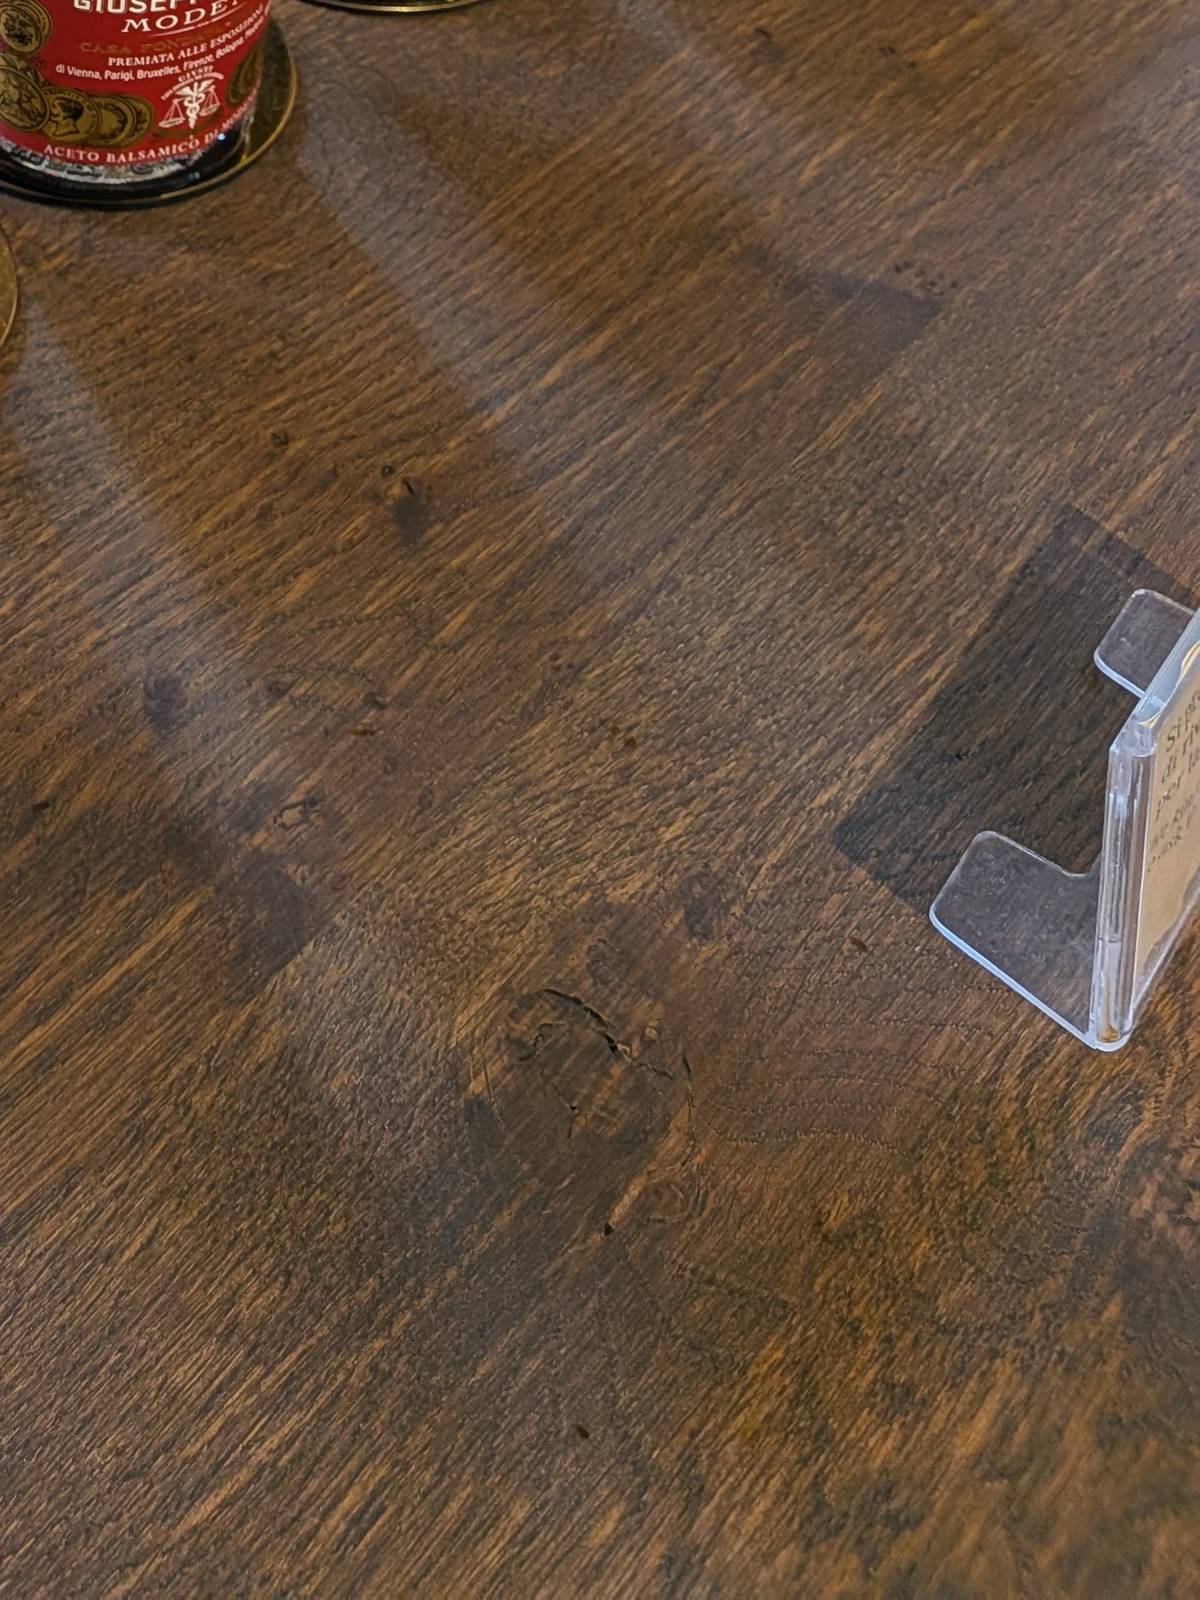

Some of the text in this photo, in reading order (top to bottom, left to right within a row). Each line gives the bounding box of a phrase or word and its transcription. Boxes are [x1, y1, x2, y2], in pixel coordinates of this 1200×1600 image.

[79, 41, 133, 55] CASA
[107, 42, 208, 67] PREMIATA ALLE
[55, 64, 66, 75] di
[66, 64, 103, 81] Vienna,
[104, 69, 136, 82] Parigi,
[136, 64, 182, 80] Bruxelles,
[43, 128, 219, 164] ACETO BALSAMICO DI
